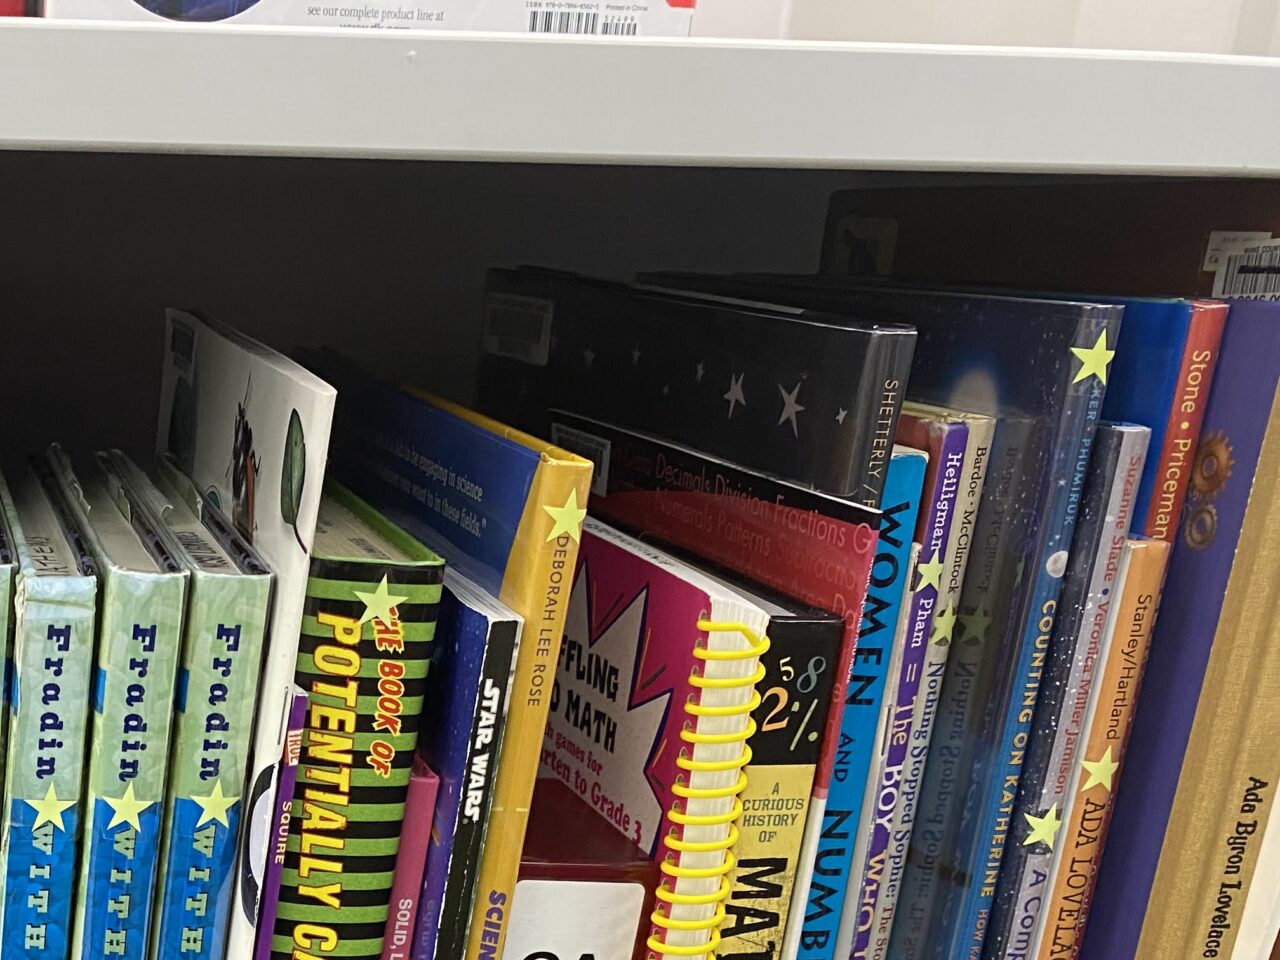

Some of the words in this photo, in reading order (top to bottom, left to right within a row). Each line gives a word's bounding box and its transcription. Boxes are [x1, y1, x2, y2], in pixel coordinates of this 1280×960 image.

[308, 7, 321, 17] see
[322, 8, 338, 17] our
[339, 6, 379, 21] complete
[381, 8, 415, 22] product
[417, 10, 433, 21] line
[435, 11, 444, 21] at
[1182, 350, 1212, 415] Stone
[1153, 437, 1193, 540] Priceman
[547, 536, 569, 621] DEBORAH
[843, 500, 911, 708] WOMEN
[536, 629, 552, 657] LEE
[1105, 593, 1153, 741] Stanley/Hartland
[36, 624, 71, 780] Fradin
[119, 624, 157, 782] Fradin
[199, 624, 242, 781] Fradin
[470, 678, 500, 749] STAR
[528, 664, 545, 707] ROSE
[296, 610, 363, 909] POTENTIALLY
[460, 752, 489, 822] WARS
[773, 782, 780, 795] A
[833, 734, 856, 783] AND
[743, 799, 804, 811] CURIOUS
[743, 814, 798, 827] HISTORY
[1075, 799, 1107, 849] ADA
[1248, 776, 1269, 814] Ada
[759, 831, 776, 843] OF
[1224, 820, 1258, 877] Byron
[1202, 881, 1243, 959] Lovelace
